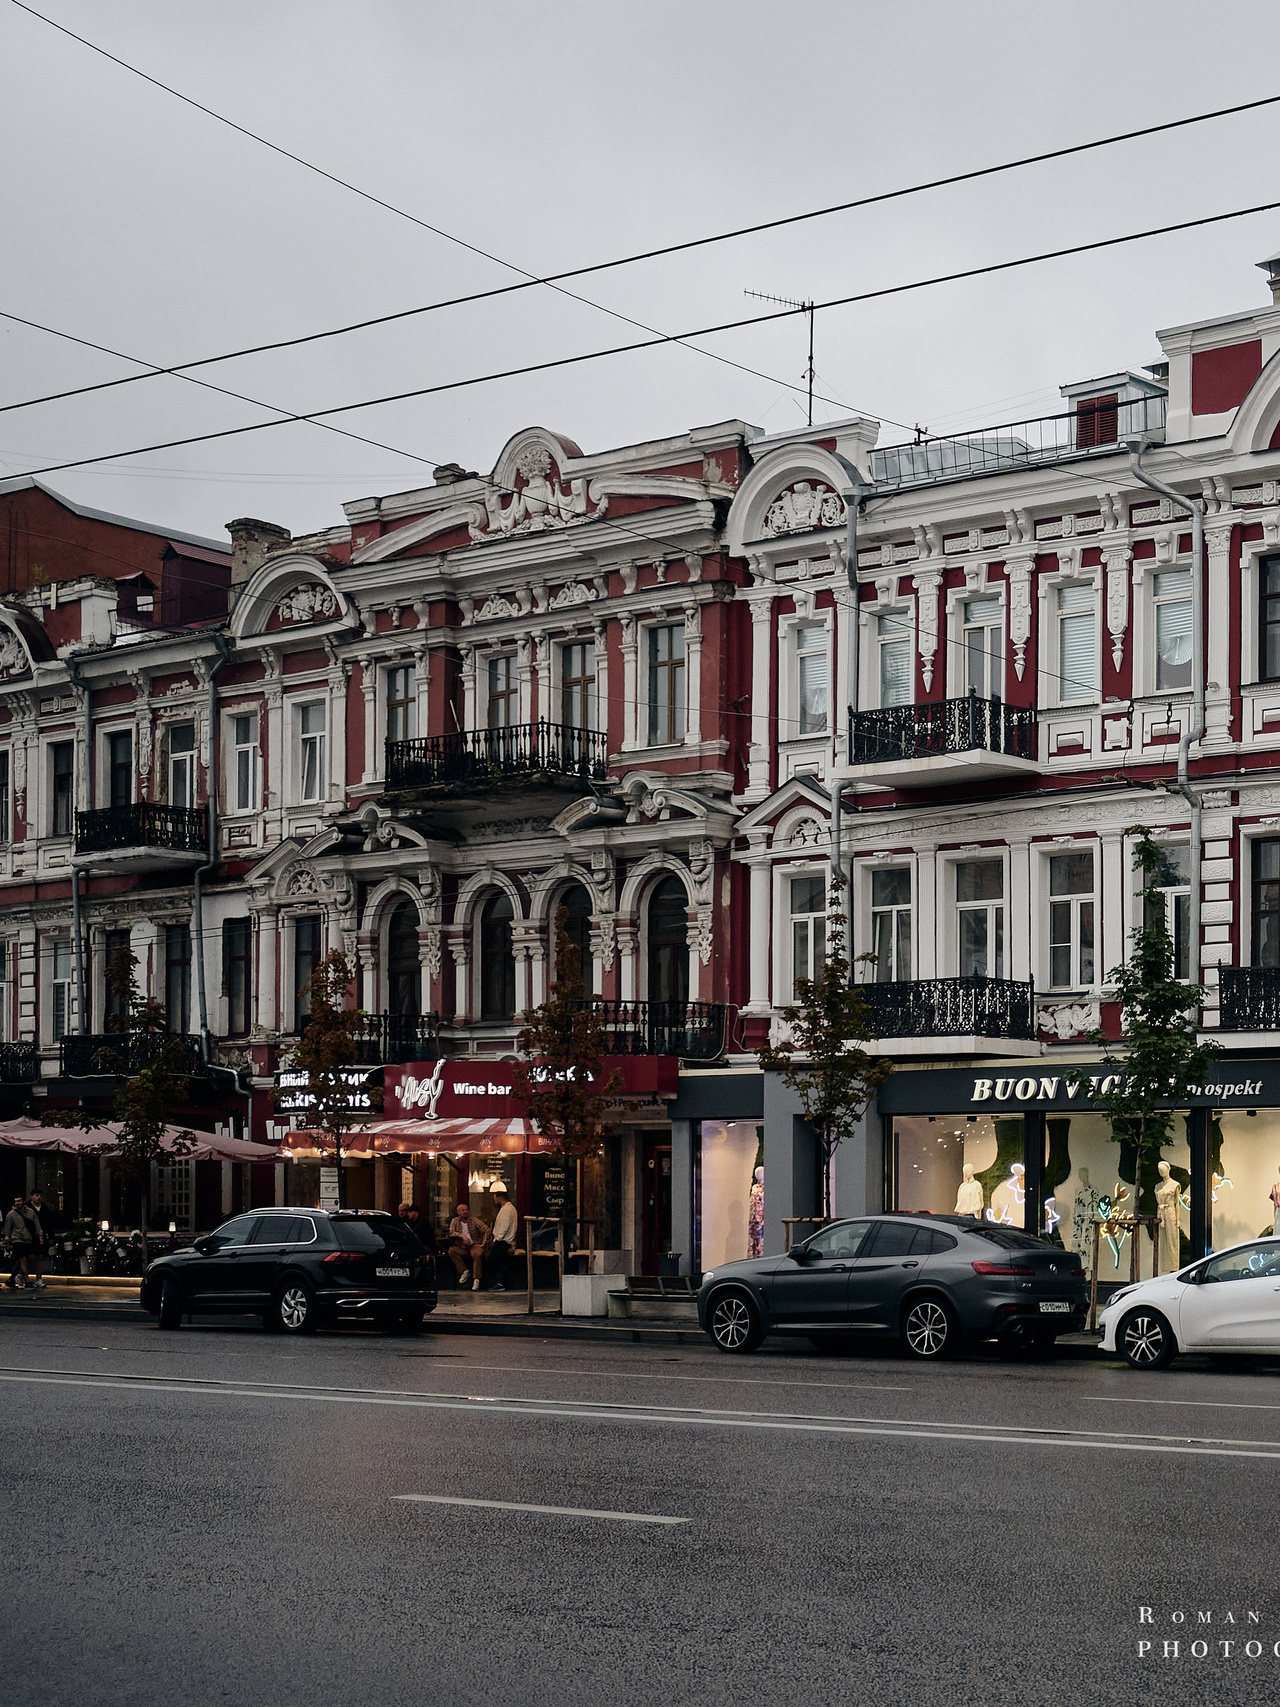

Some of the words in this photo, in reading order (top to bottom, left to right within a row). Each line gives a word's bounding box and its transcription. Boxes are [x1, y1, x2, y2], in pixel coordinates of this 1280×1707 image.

[453, 1082, 486, 1095] Wine
[487, 1082, 512, 1095] bar
[970, 1077, 1058, 1101] BUON
[544, 1171, 565, 1179] Вино
[546, 1196, 565, 1205] Сыр
